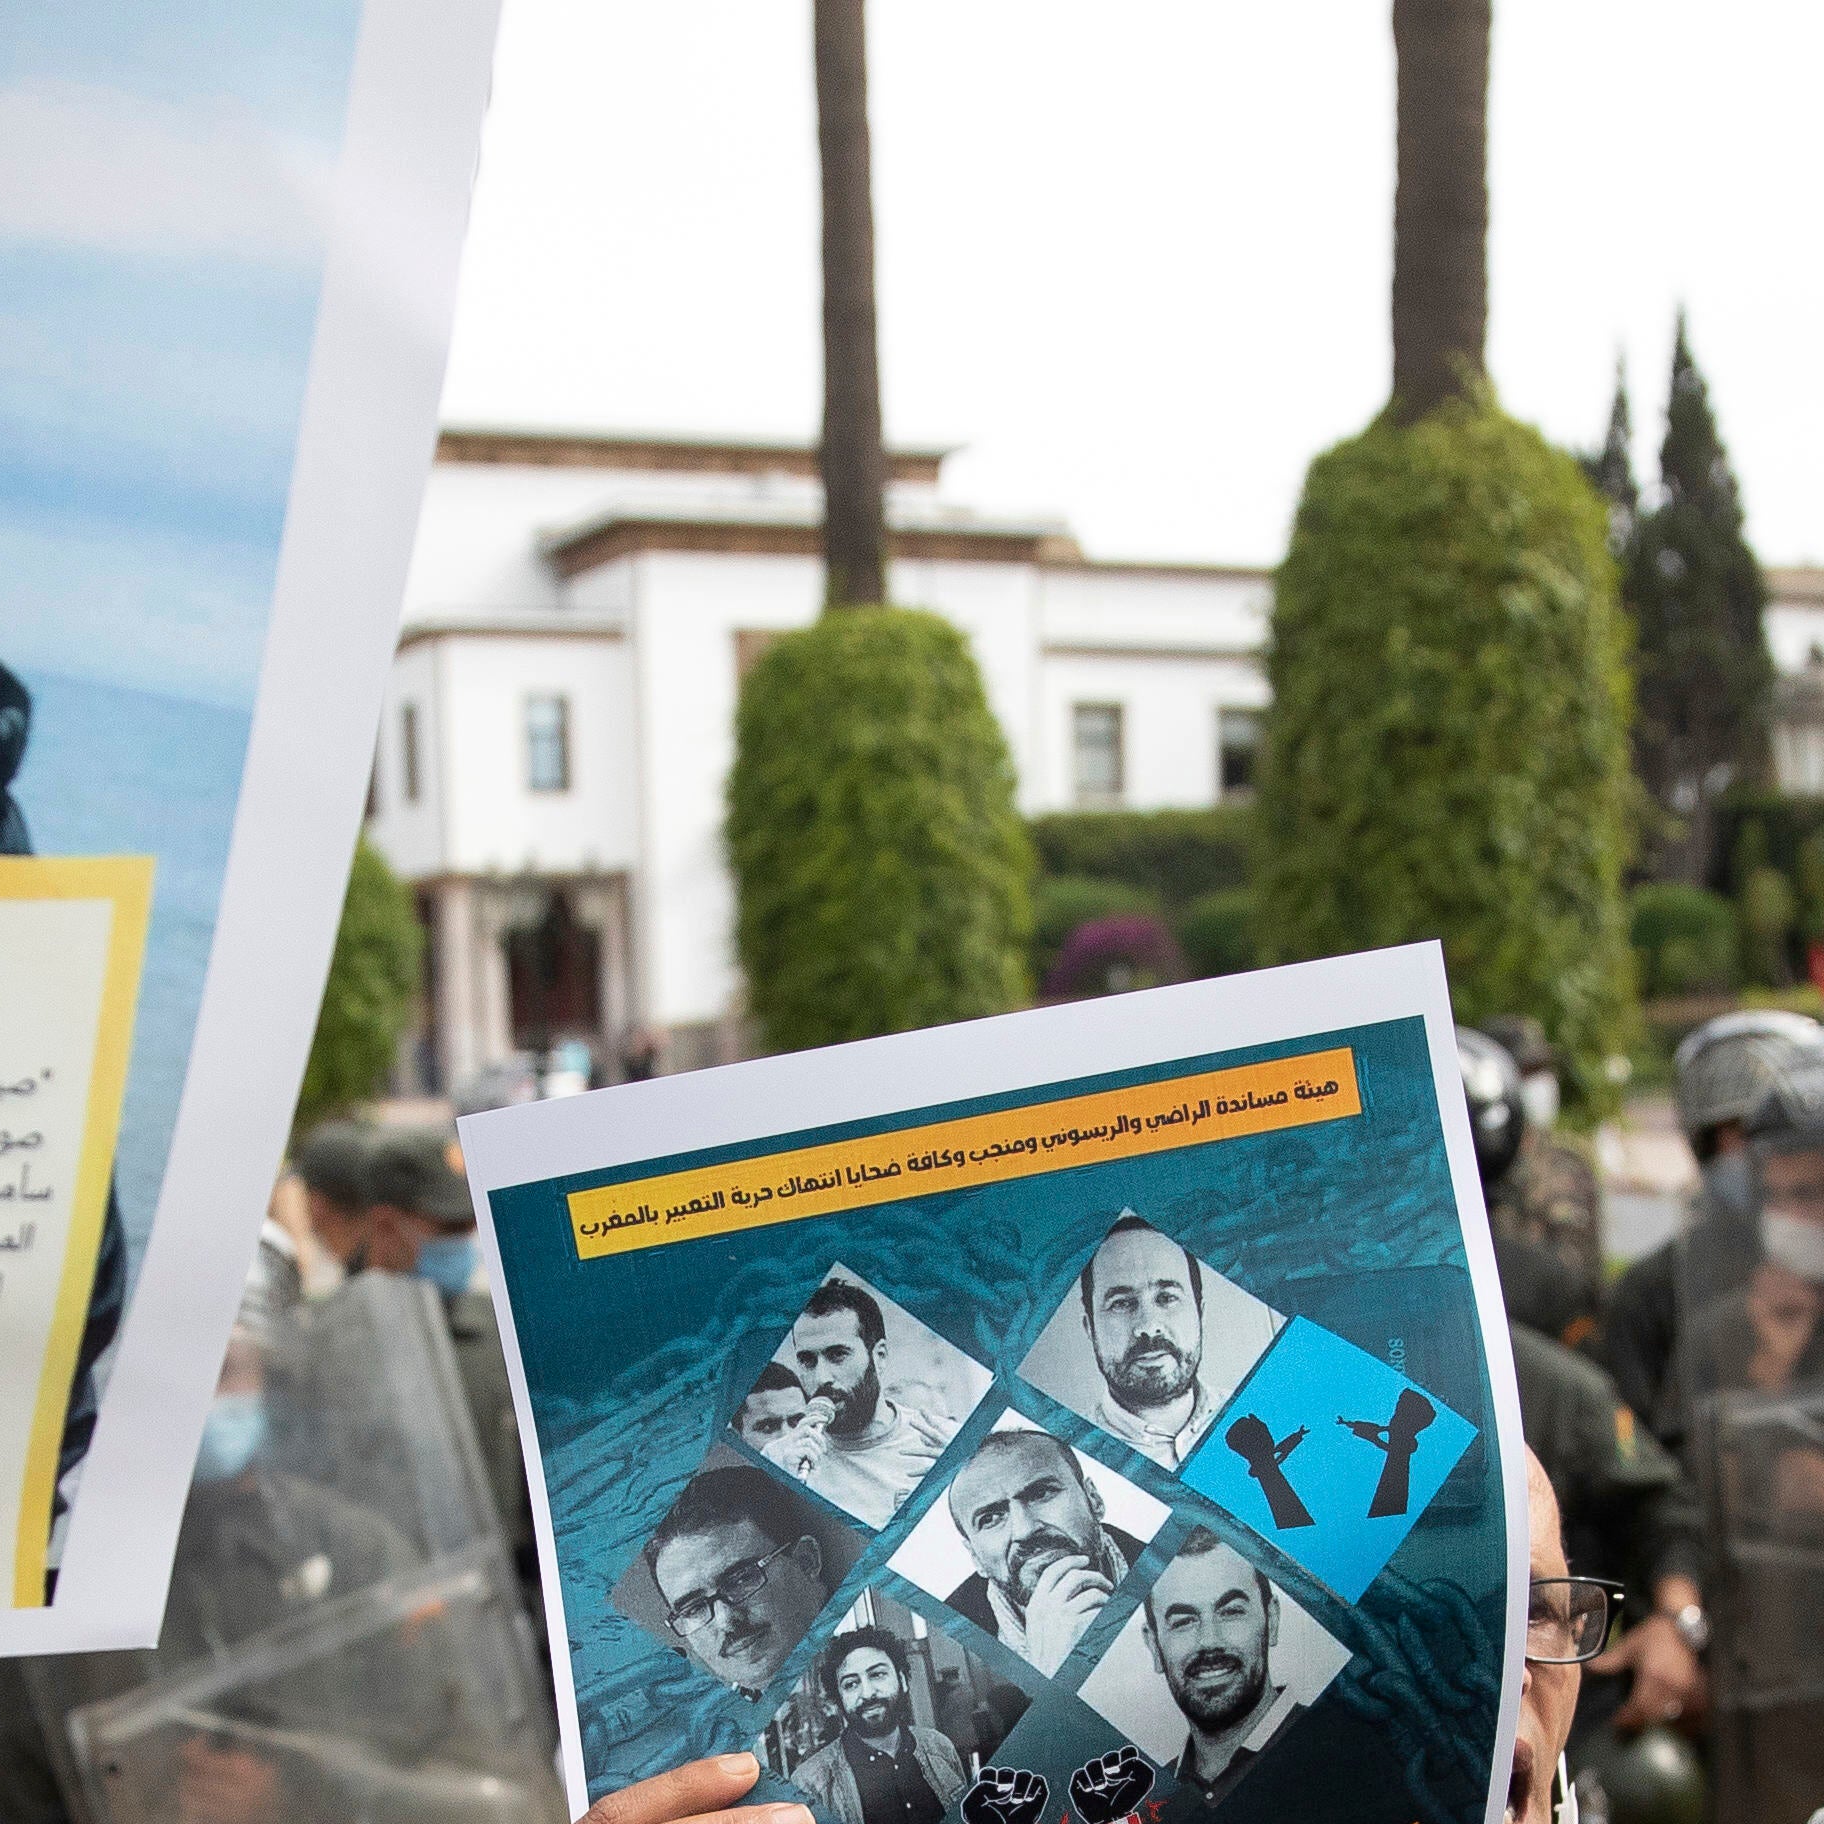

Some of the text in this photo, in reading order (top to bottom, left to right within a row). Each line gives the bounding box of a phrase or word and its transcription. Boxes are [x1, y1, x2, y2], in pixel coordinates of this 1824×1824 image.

[579, 1078, 1340, 1239] هيئة مساندة الراضي والريسوني ومنجب وكافة ضحايا انتهاك حرية التعبير بالمغرب
